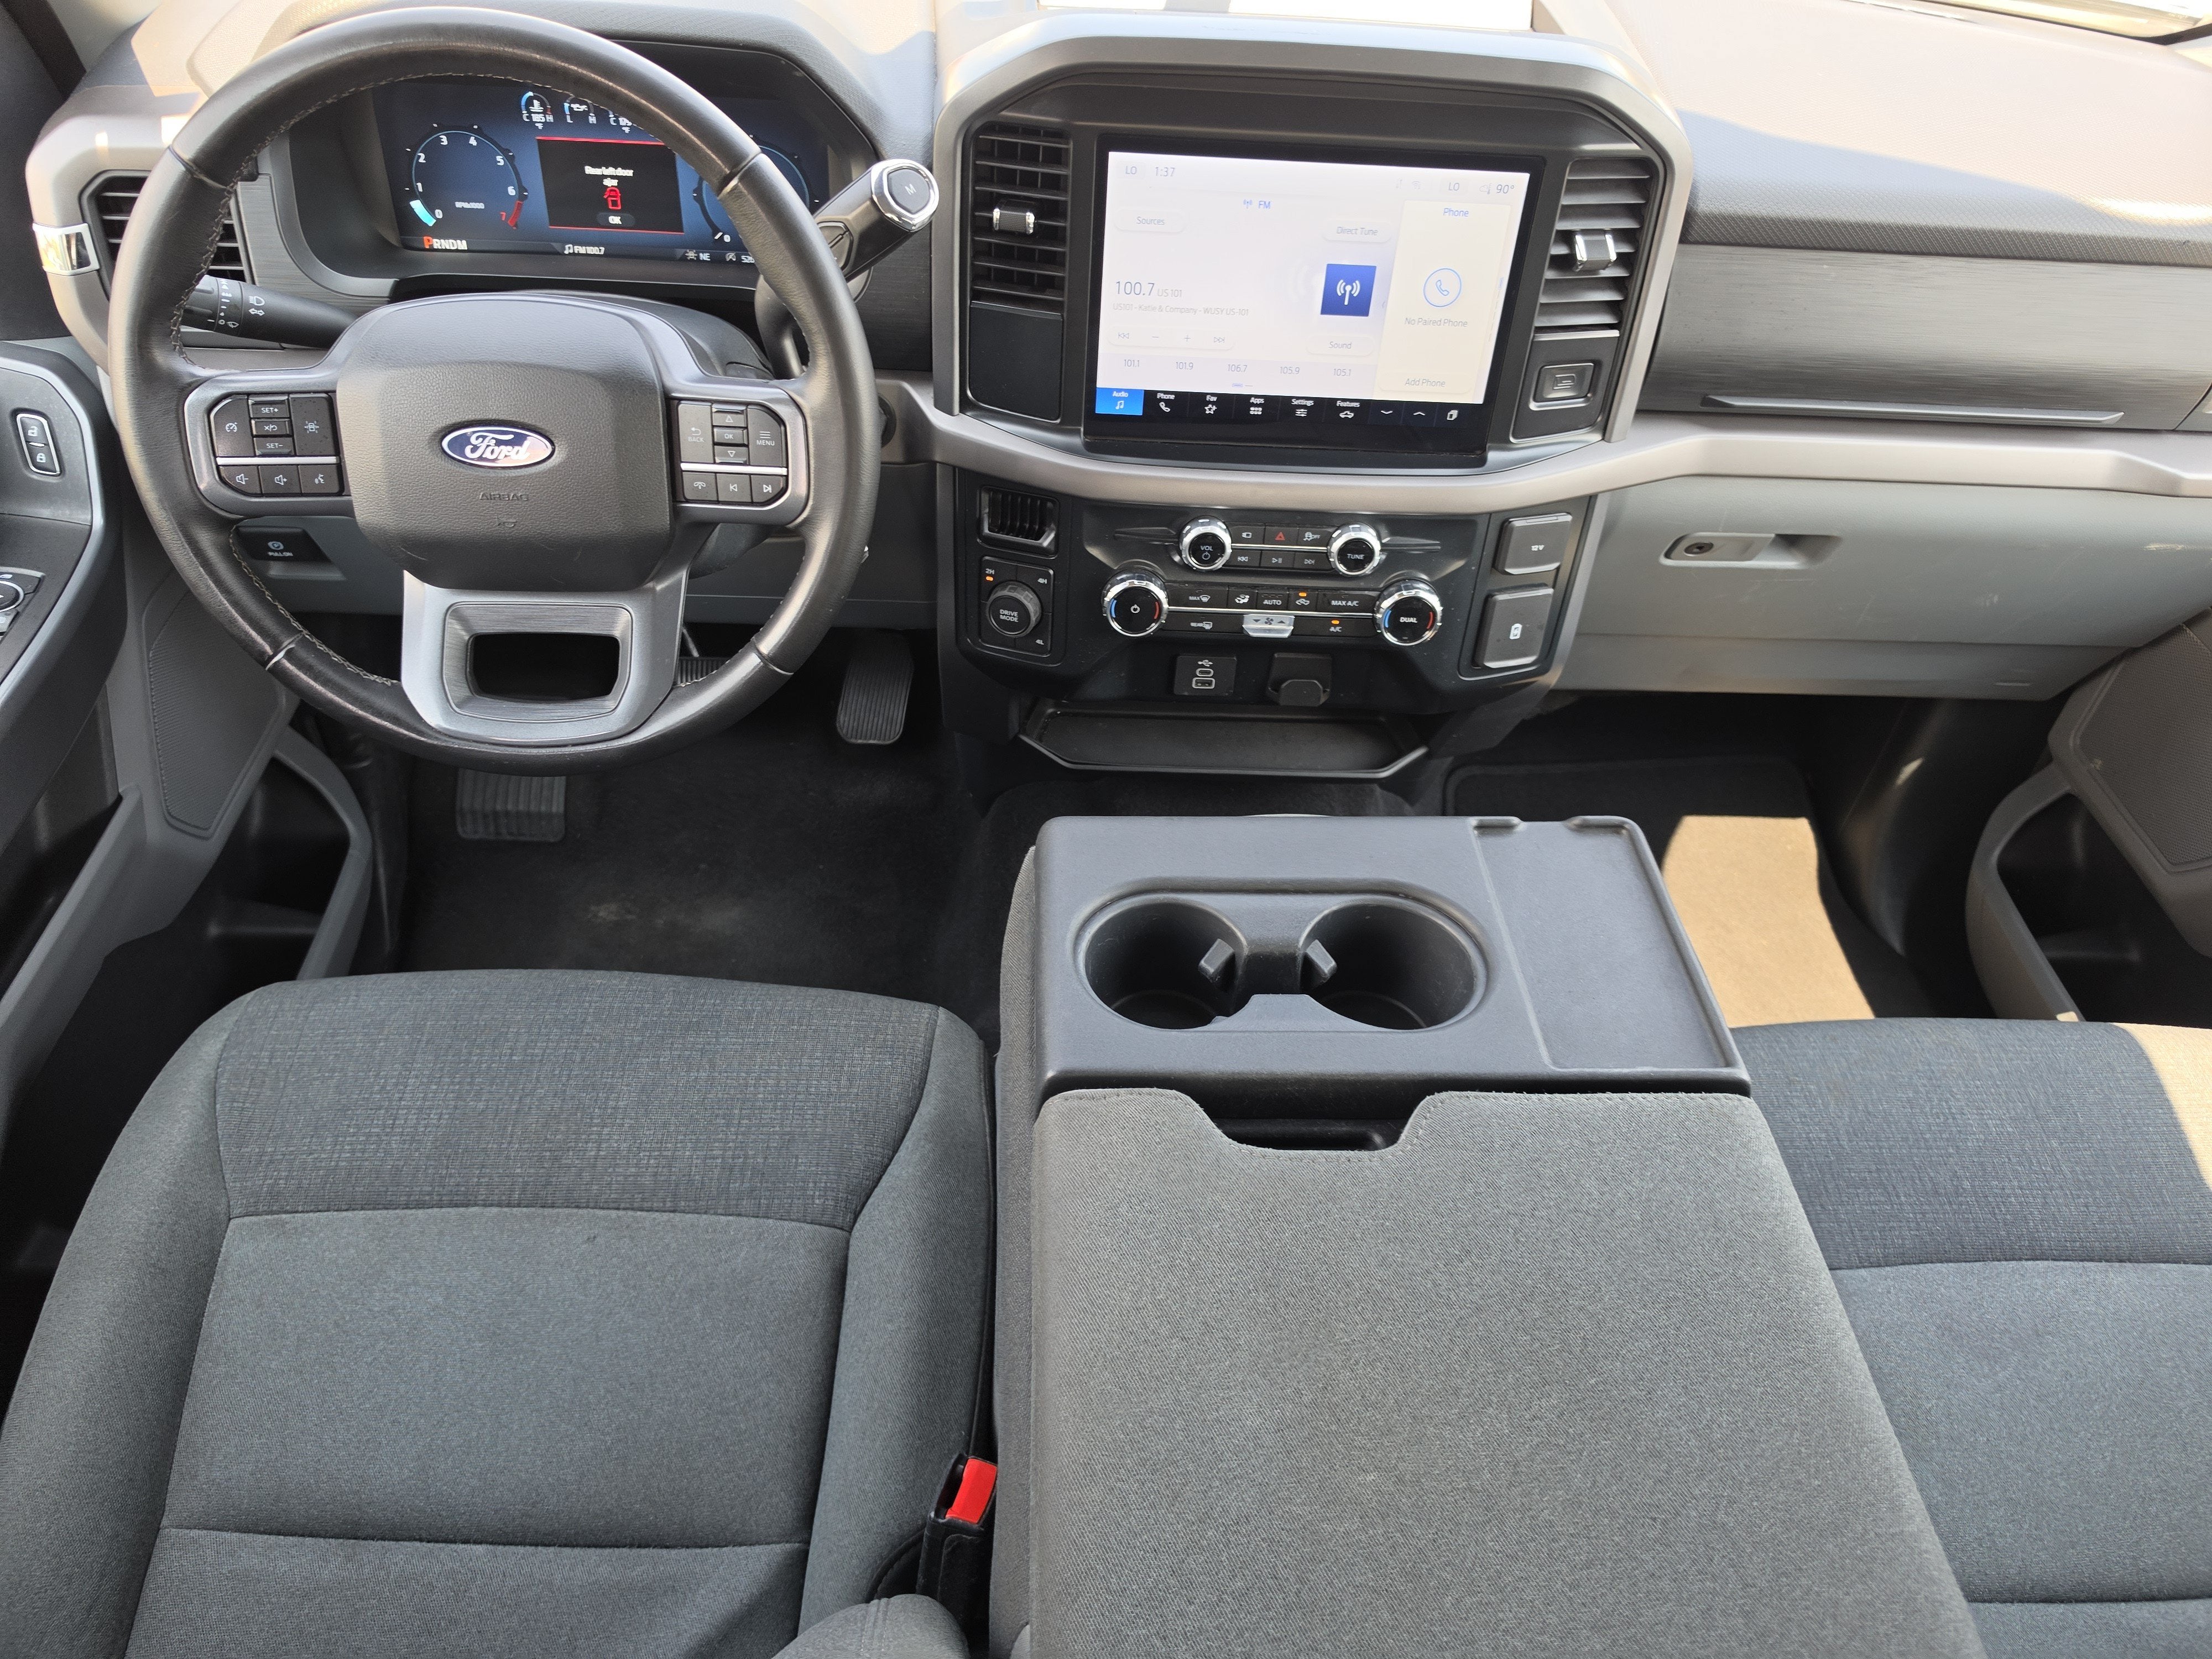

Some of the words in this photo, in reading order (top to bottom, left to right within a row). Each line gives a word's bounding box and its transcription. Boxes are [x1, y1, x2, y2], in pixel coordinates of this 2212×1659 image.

[440, 135, 448, 145] 3
[469, 136, 477, 146] 4
[417, 153, 426, 163] 2
[496, 155, 504, 166] 5
[1125, 166, 1138, 175] LO
[1155, 166, 1176, 178] 1:37
[416, 182, 423, 192] 1
[508, 186, 516, 196] 6
[904, 183, 917, 196] M
[1448, 182, 1460, 192] LO
[1496, 184, 1515, 195] 90°
[1258, 200, 1271, 210] FM
[435, 209, 443, 218] 0
[500, 212, 506, 221] 7
[1443, 208, 1469, 218] Phone
[608, 216, 622, 225] OK
[1136, 216, 1165, 226] Sources
[1336, 226, 1358, 236] Direct
[1359, 227, 1379, 237] Tune
[698, 252, 711, 261] NE
[1115, 280, 1155, 297] 100.7
[1405, 317, 1416, 326] No
[1417, 318, 1442, 327] Paired
[1443, 319, 1468, 328] Phone
[1328, 341, 1352, 350] Sound
[1123, 358, 1140, 368] 101.1
[1175, 361, 1194, 371] 101.9
[1227, 364, 1248, 373] 106.7
[1279, 366, 1301, 375] 105.9
[1333, 368, 1352, 378] 105.1
[1405, 378, 1418, 388] Add
[1420, 379, 1446, 388] Phone
[1249, 397, 1265, 405] Apps
[1291, 398, 1314, 407] Settings
[465, 431, 531, 461] Ford
[1000, 609, 1019, 617] DRIVE
[1000, 614, 1019, 623] MODE
